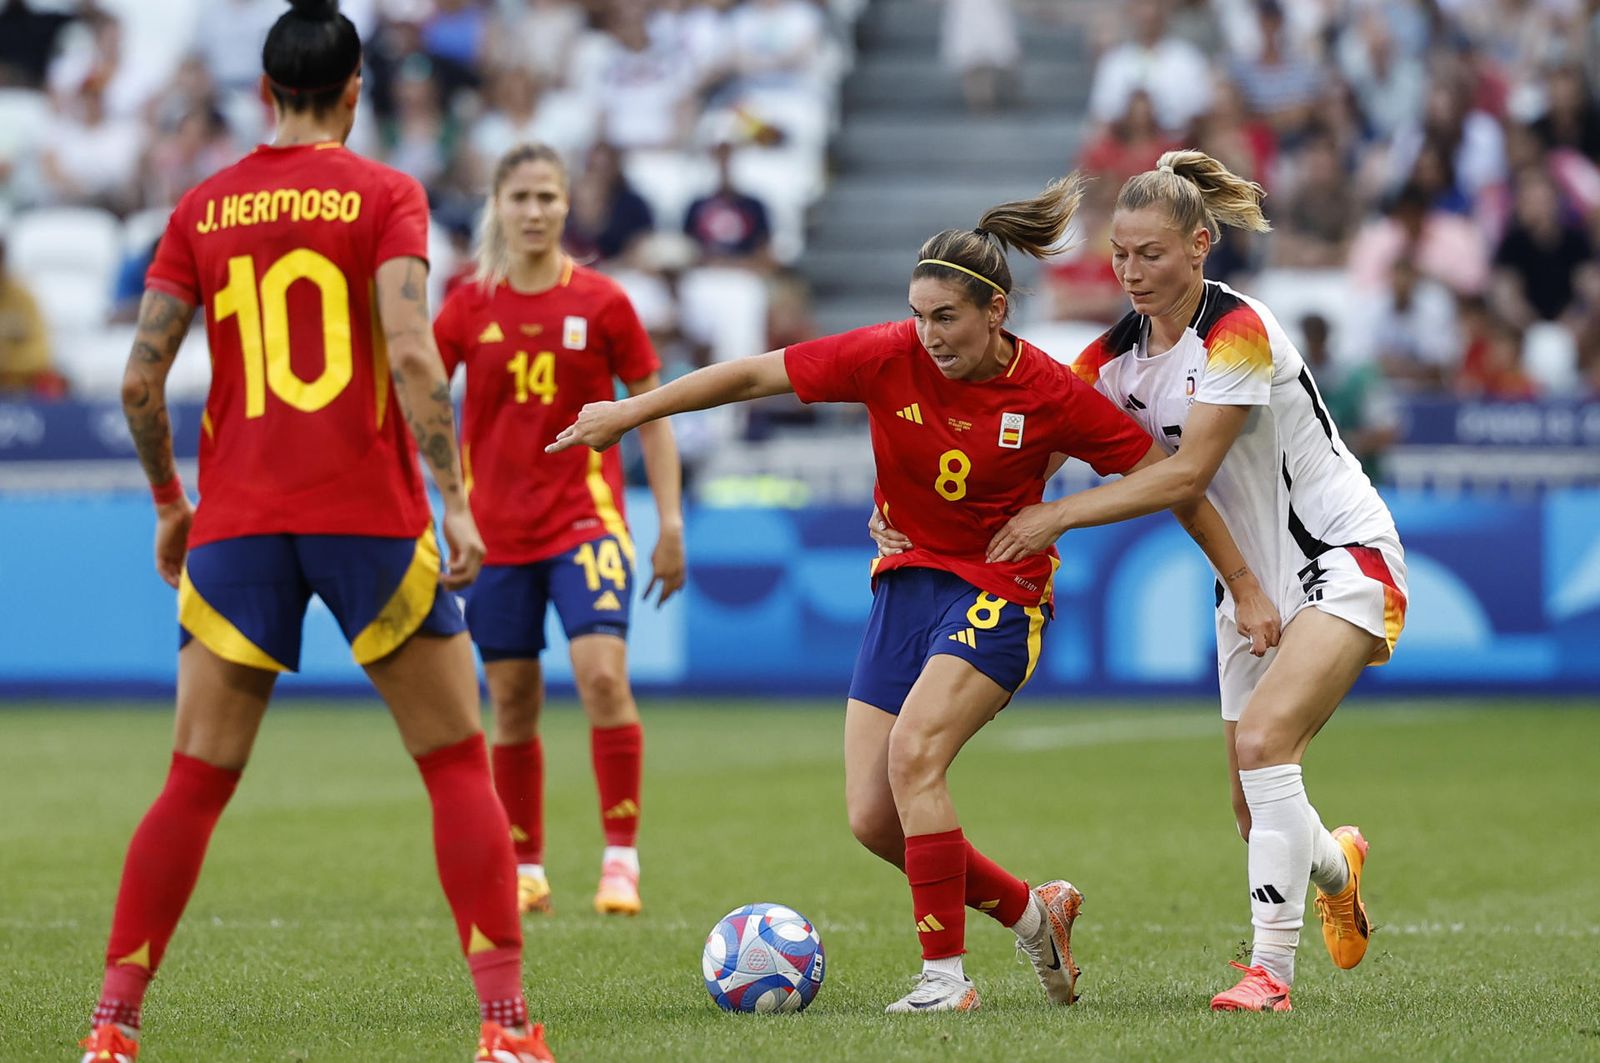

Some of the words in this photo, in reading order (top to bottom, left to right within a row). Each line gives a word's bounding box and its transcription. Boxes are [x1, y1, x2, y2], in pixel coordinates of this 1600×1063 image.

[214, 248, 353, 419] 10
[507, 351, 558, 405] 14
[935, 449, 971, 501] 8
[573, 539, 626, 592] 14
[966, 590, 1008, 629] 8
